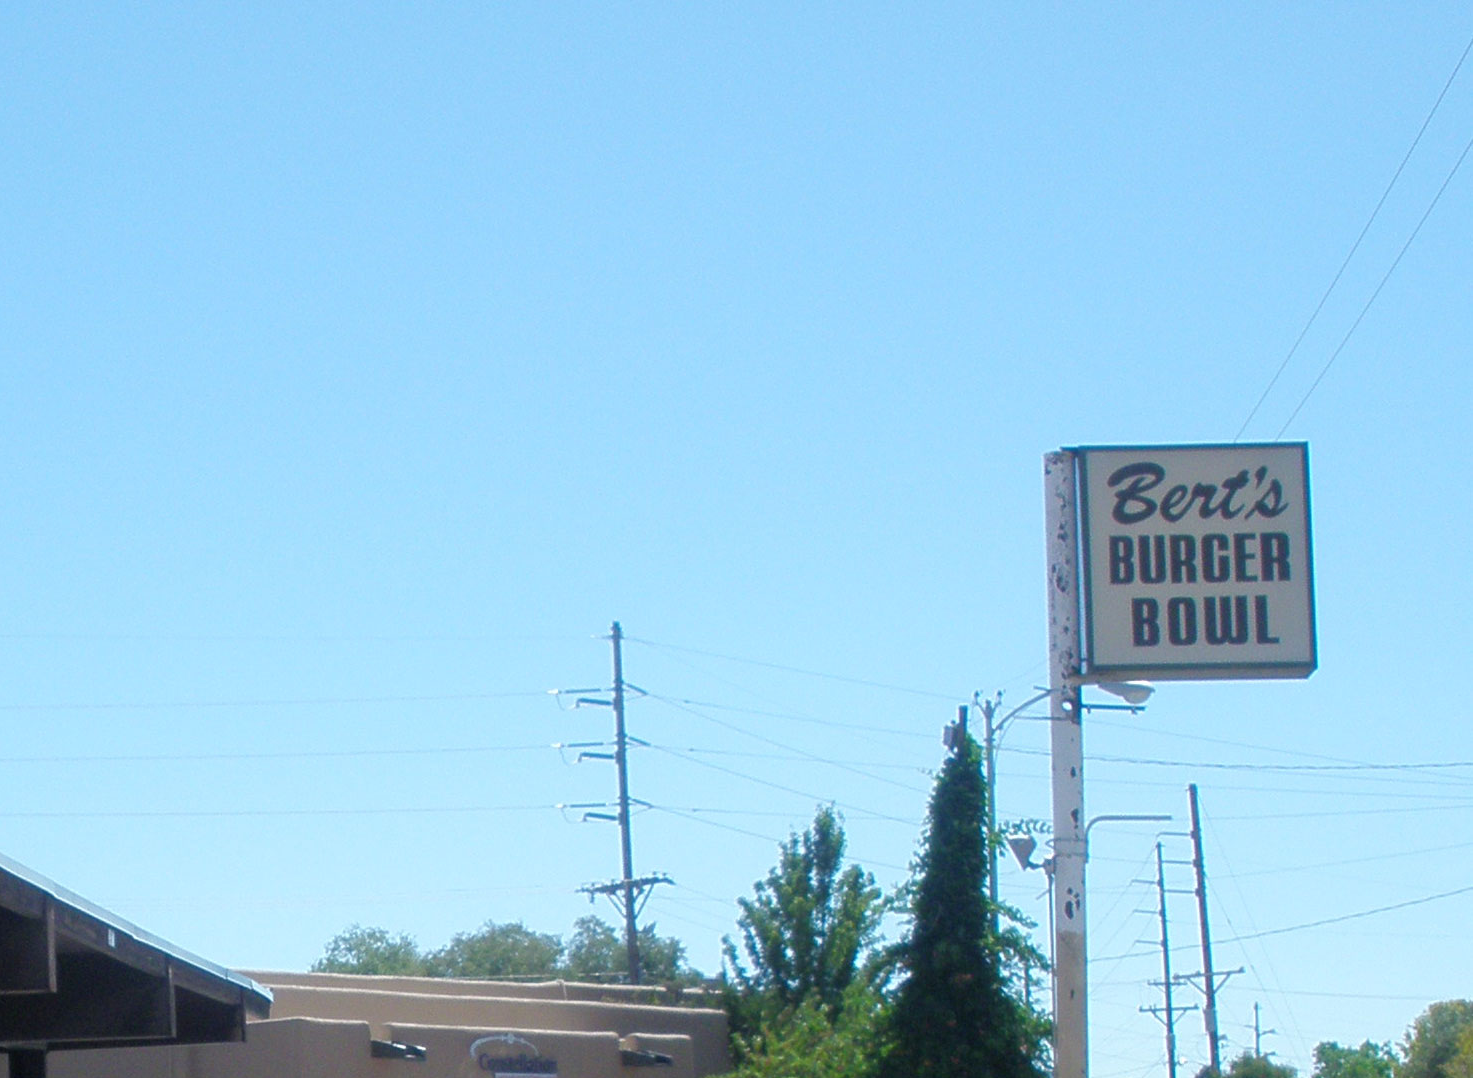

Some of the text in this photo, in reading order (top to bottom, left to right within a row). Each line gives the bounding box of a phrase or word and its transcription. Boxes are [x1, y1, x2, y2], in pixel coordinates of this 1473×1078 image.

[1108, 462, 1288, 525] Bert's
[1110, 532, 1290, 585] BURGER
[1132, 595, 1279, 647] BOWL
